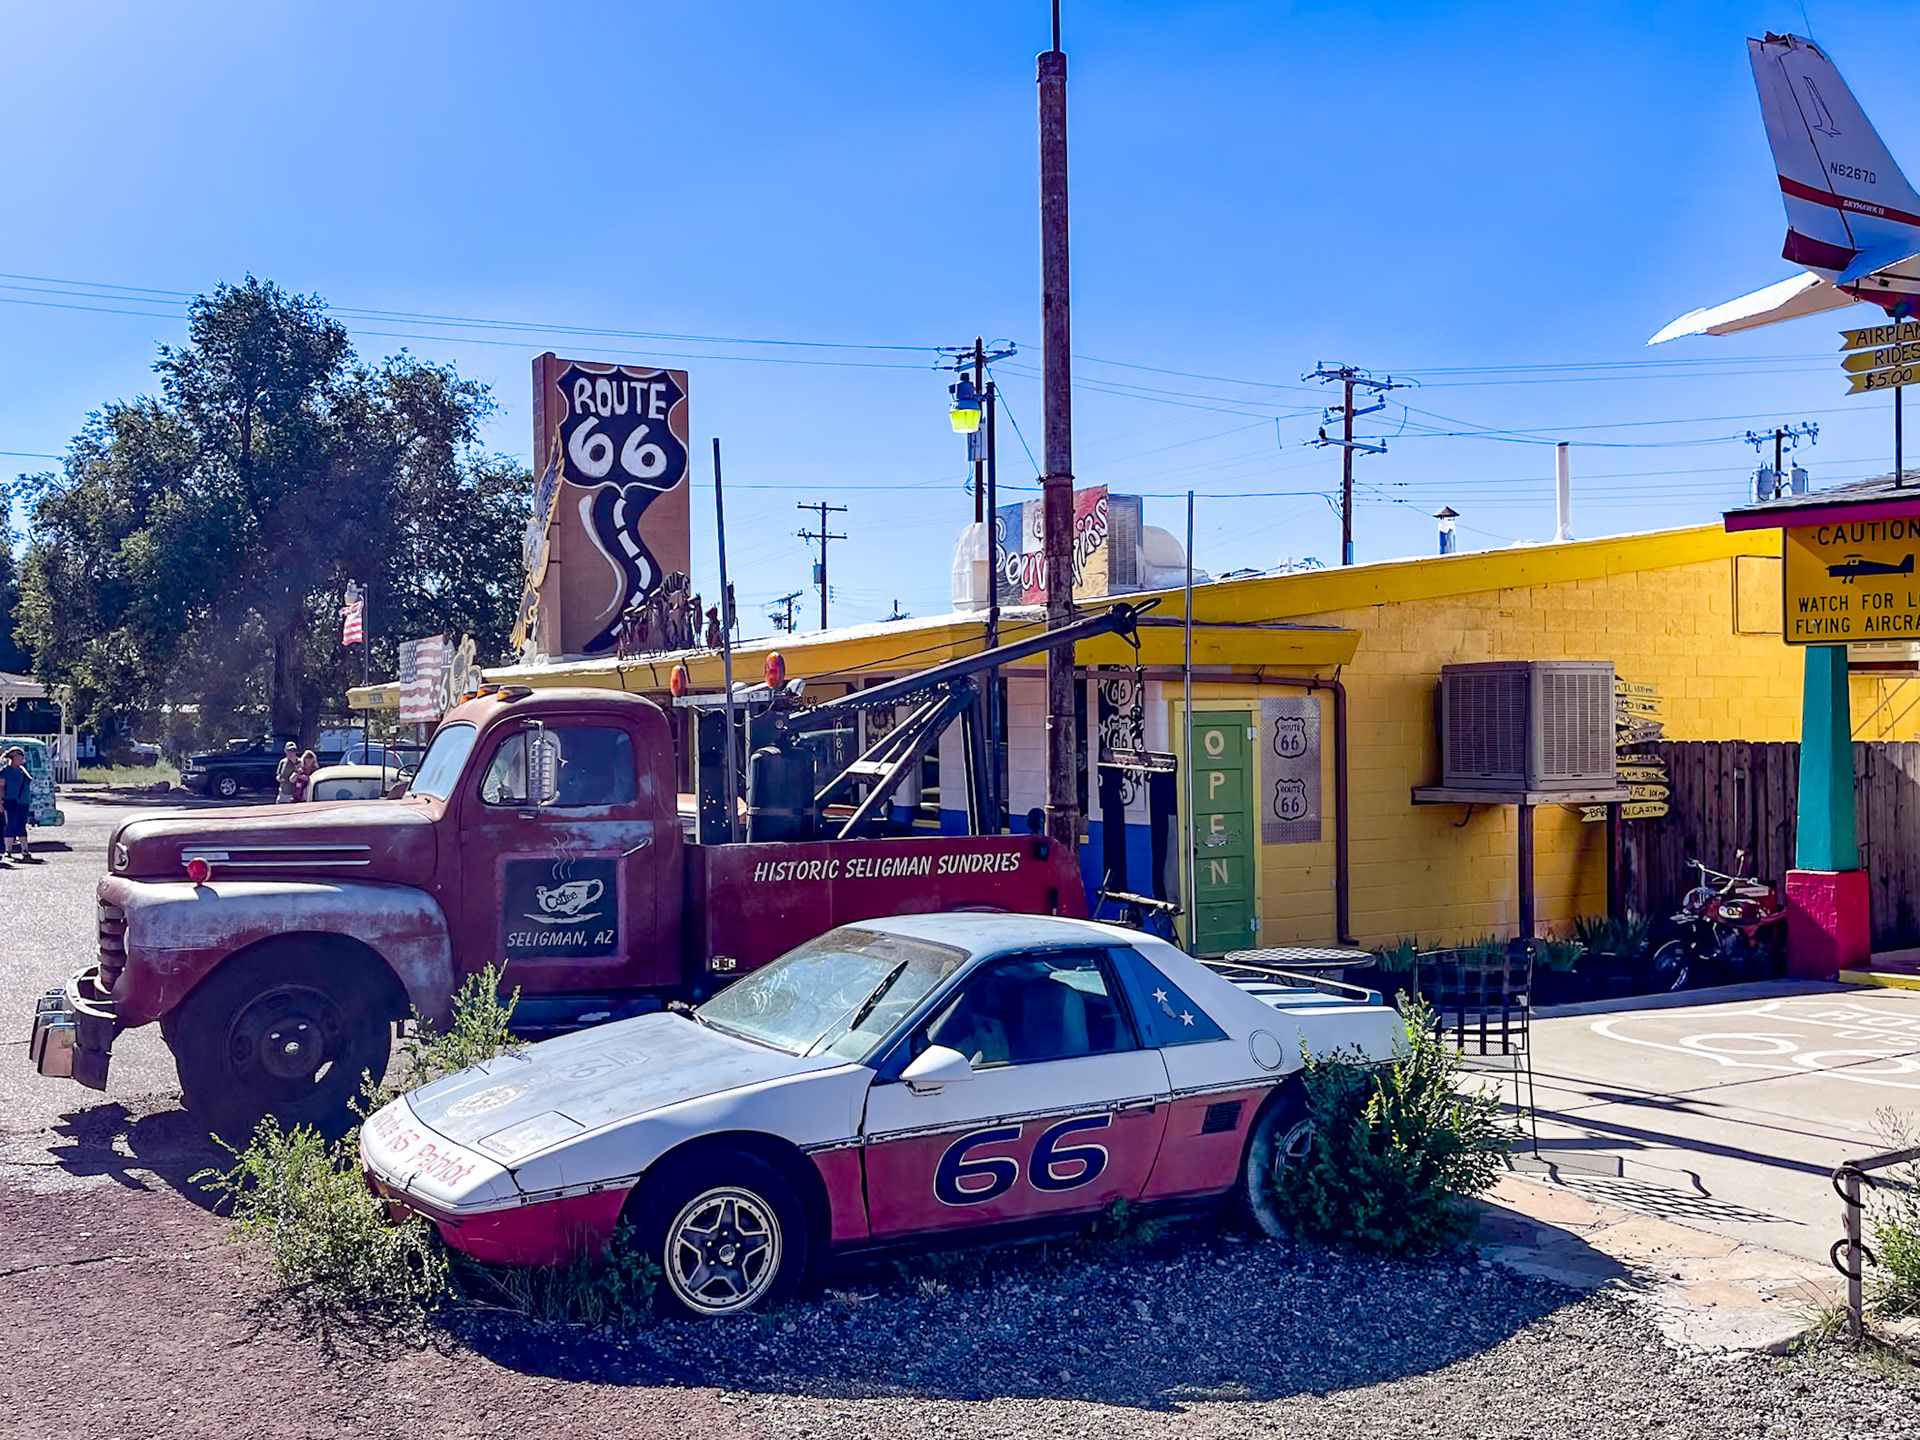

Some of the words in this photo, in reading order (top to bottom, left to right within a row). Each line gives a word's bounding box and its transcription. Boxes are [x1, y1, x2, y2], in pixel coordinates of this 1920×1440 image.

[1830, 161, 1876, 184] N6267D
[1843, 199, 1877, 213] SKYHAWK
[1875, 343, 1920, 366] RIDES
[1864, 368, 1912, 390] $5.00
[573, 377, 666, 420] ROUTE
[568, 416, 667, 479] 66
[1818, 519, 1920, 546] CAUTION
[1799, 595, 1849, 612] WATCH
[1862, 593, 1894, 610] FOR
[1796, 617, 1850, 634] FLYING
[1110, 682, 1127, 699] 66
[1112, 733, 1128, 749] 66
[1281, 734, 1299, 751] 66
[1203, 730, 1229, 885] OPEN
[1281, 796, 1299, 813] 66
[754, 859, 840, 882] HISTORIC
[845, 856, 932, 879] SELIGMAN
[937, 852, 1021, 875] SUNDRIES
[507, 930, 587, 947] SELIGMAN,
[594, 930, 614, 944] AZ
[933, 1112, 1114, 1207] 66
